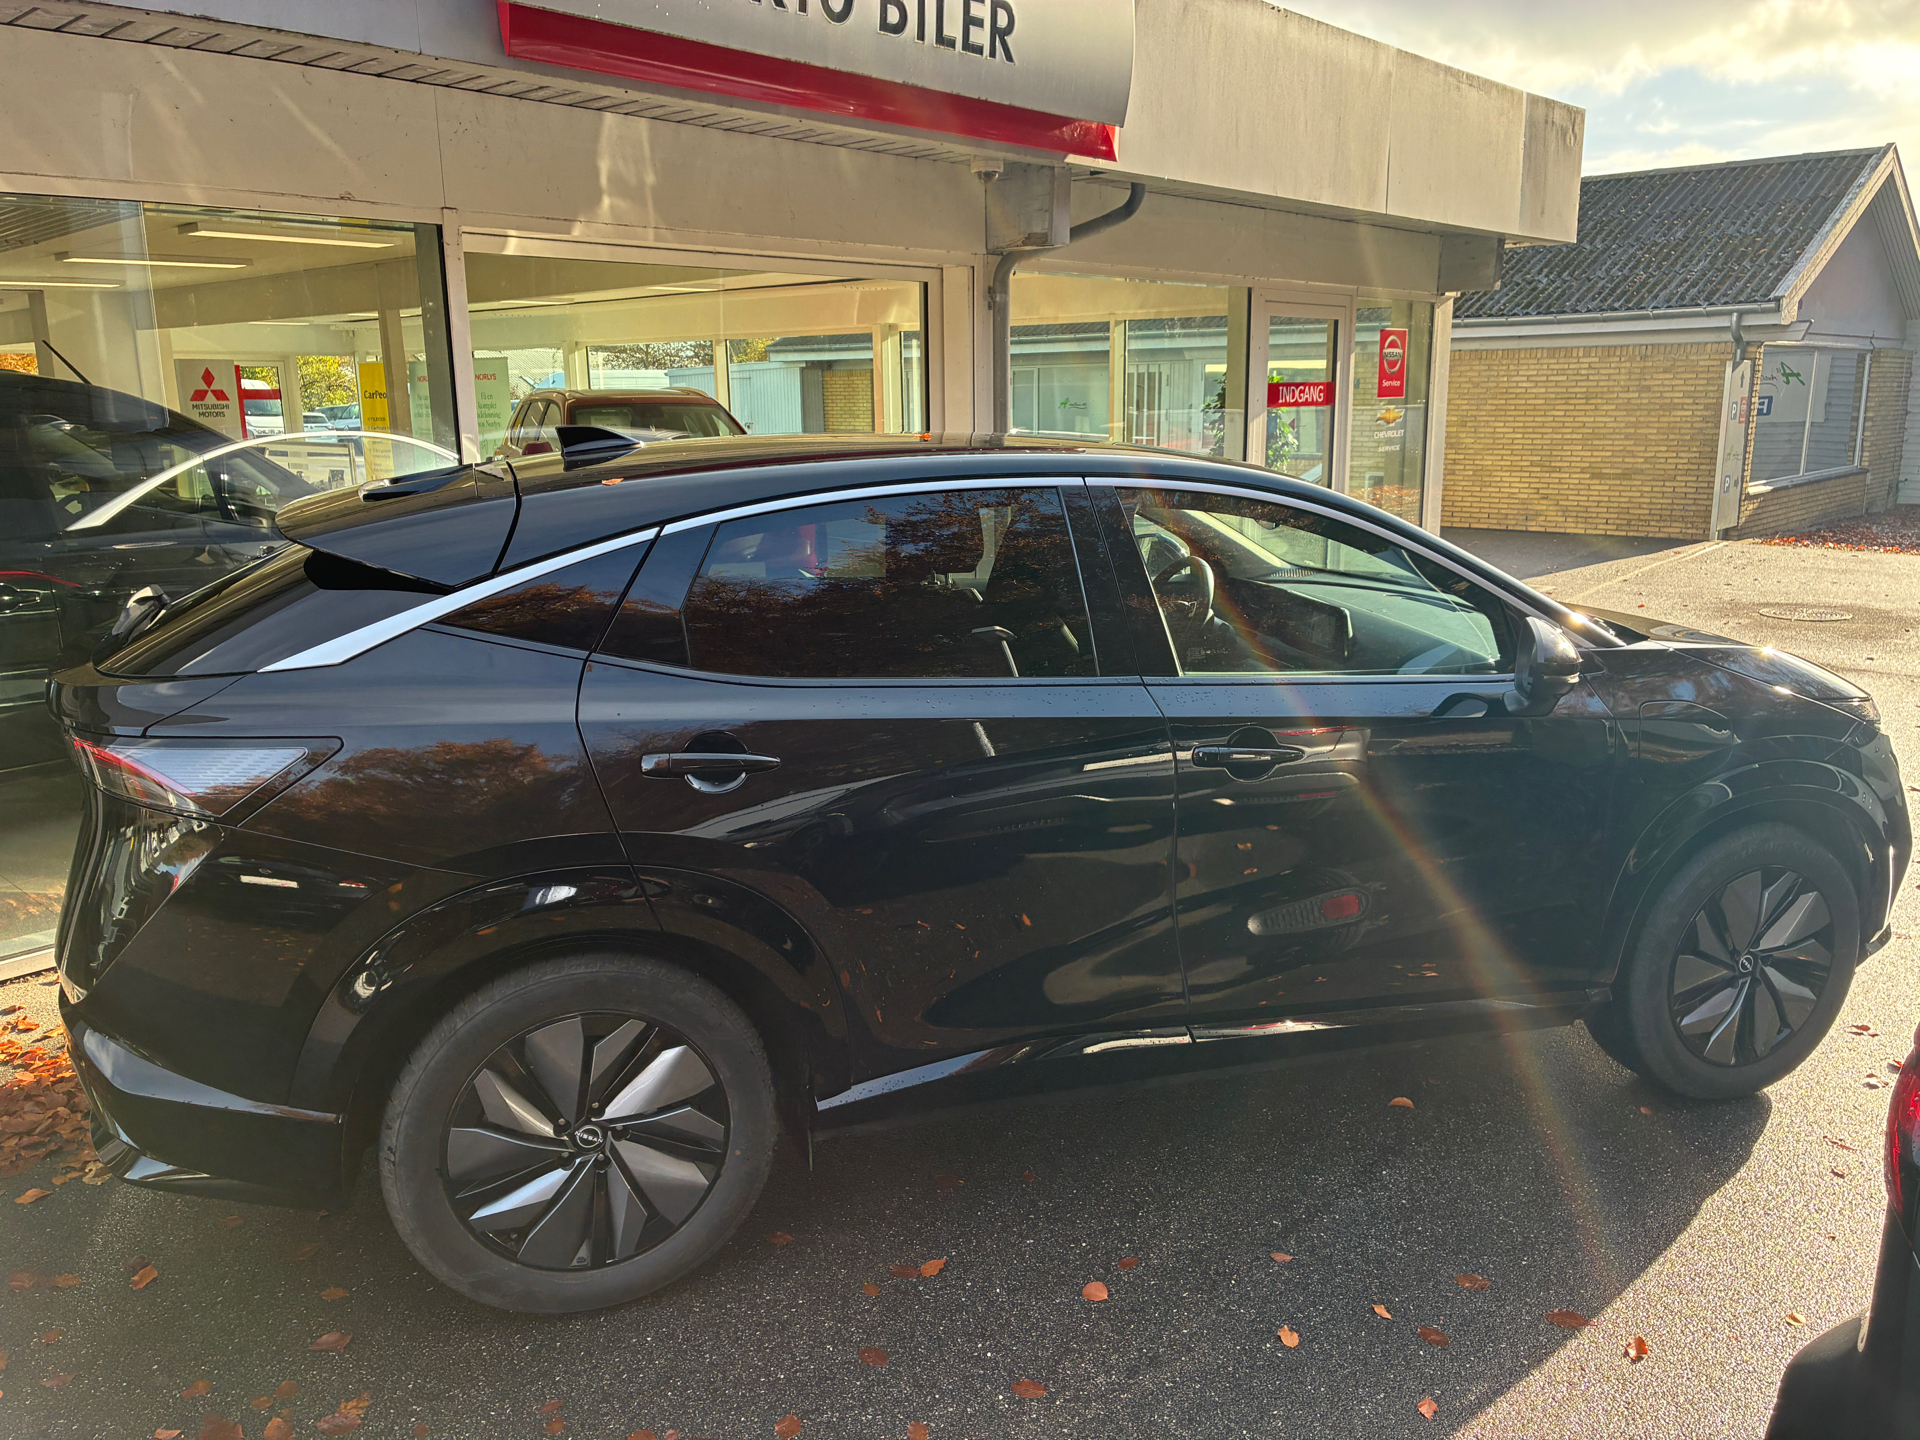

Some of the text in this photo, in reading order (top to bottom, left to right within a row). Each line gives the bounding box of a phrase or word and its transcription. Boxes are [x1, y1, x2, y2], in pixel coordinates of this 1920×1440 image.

[877, 0, 1016, 65] BILER
[474, 373, 497, 381] NORLYS
[1382, 379, 1400, 387] Service
[1278, 385, 1324, 403] INDGANG
[192, 403, 230, 411] MITSUBISHI
[1374, 430, 1405, 439] CHEVROLET
[1378, 445, 1400, 453] SERVICE
[574, 1130, 604, 1143] NISSAN
